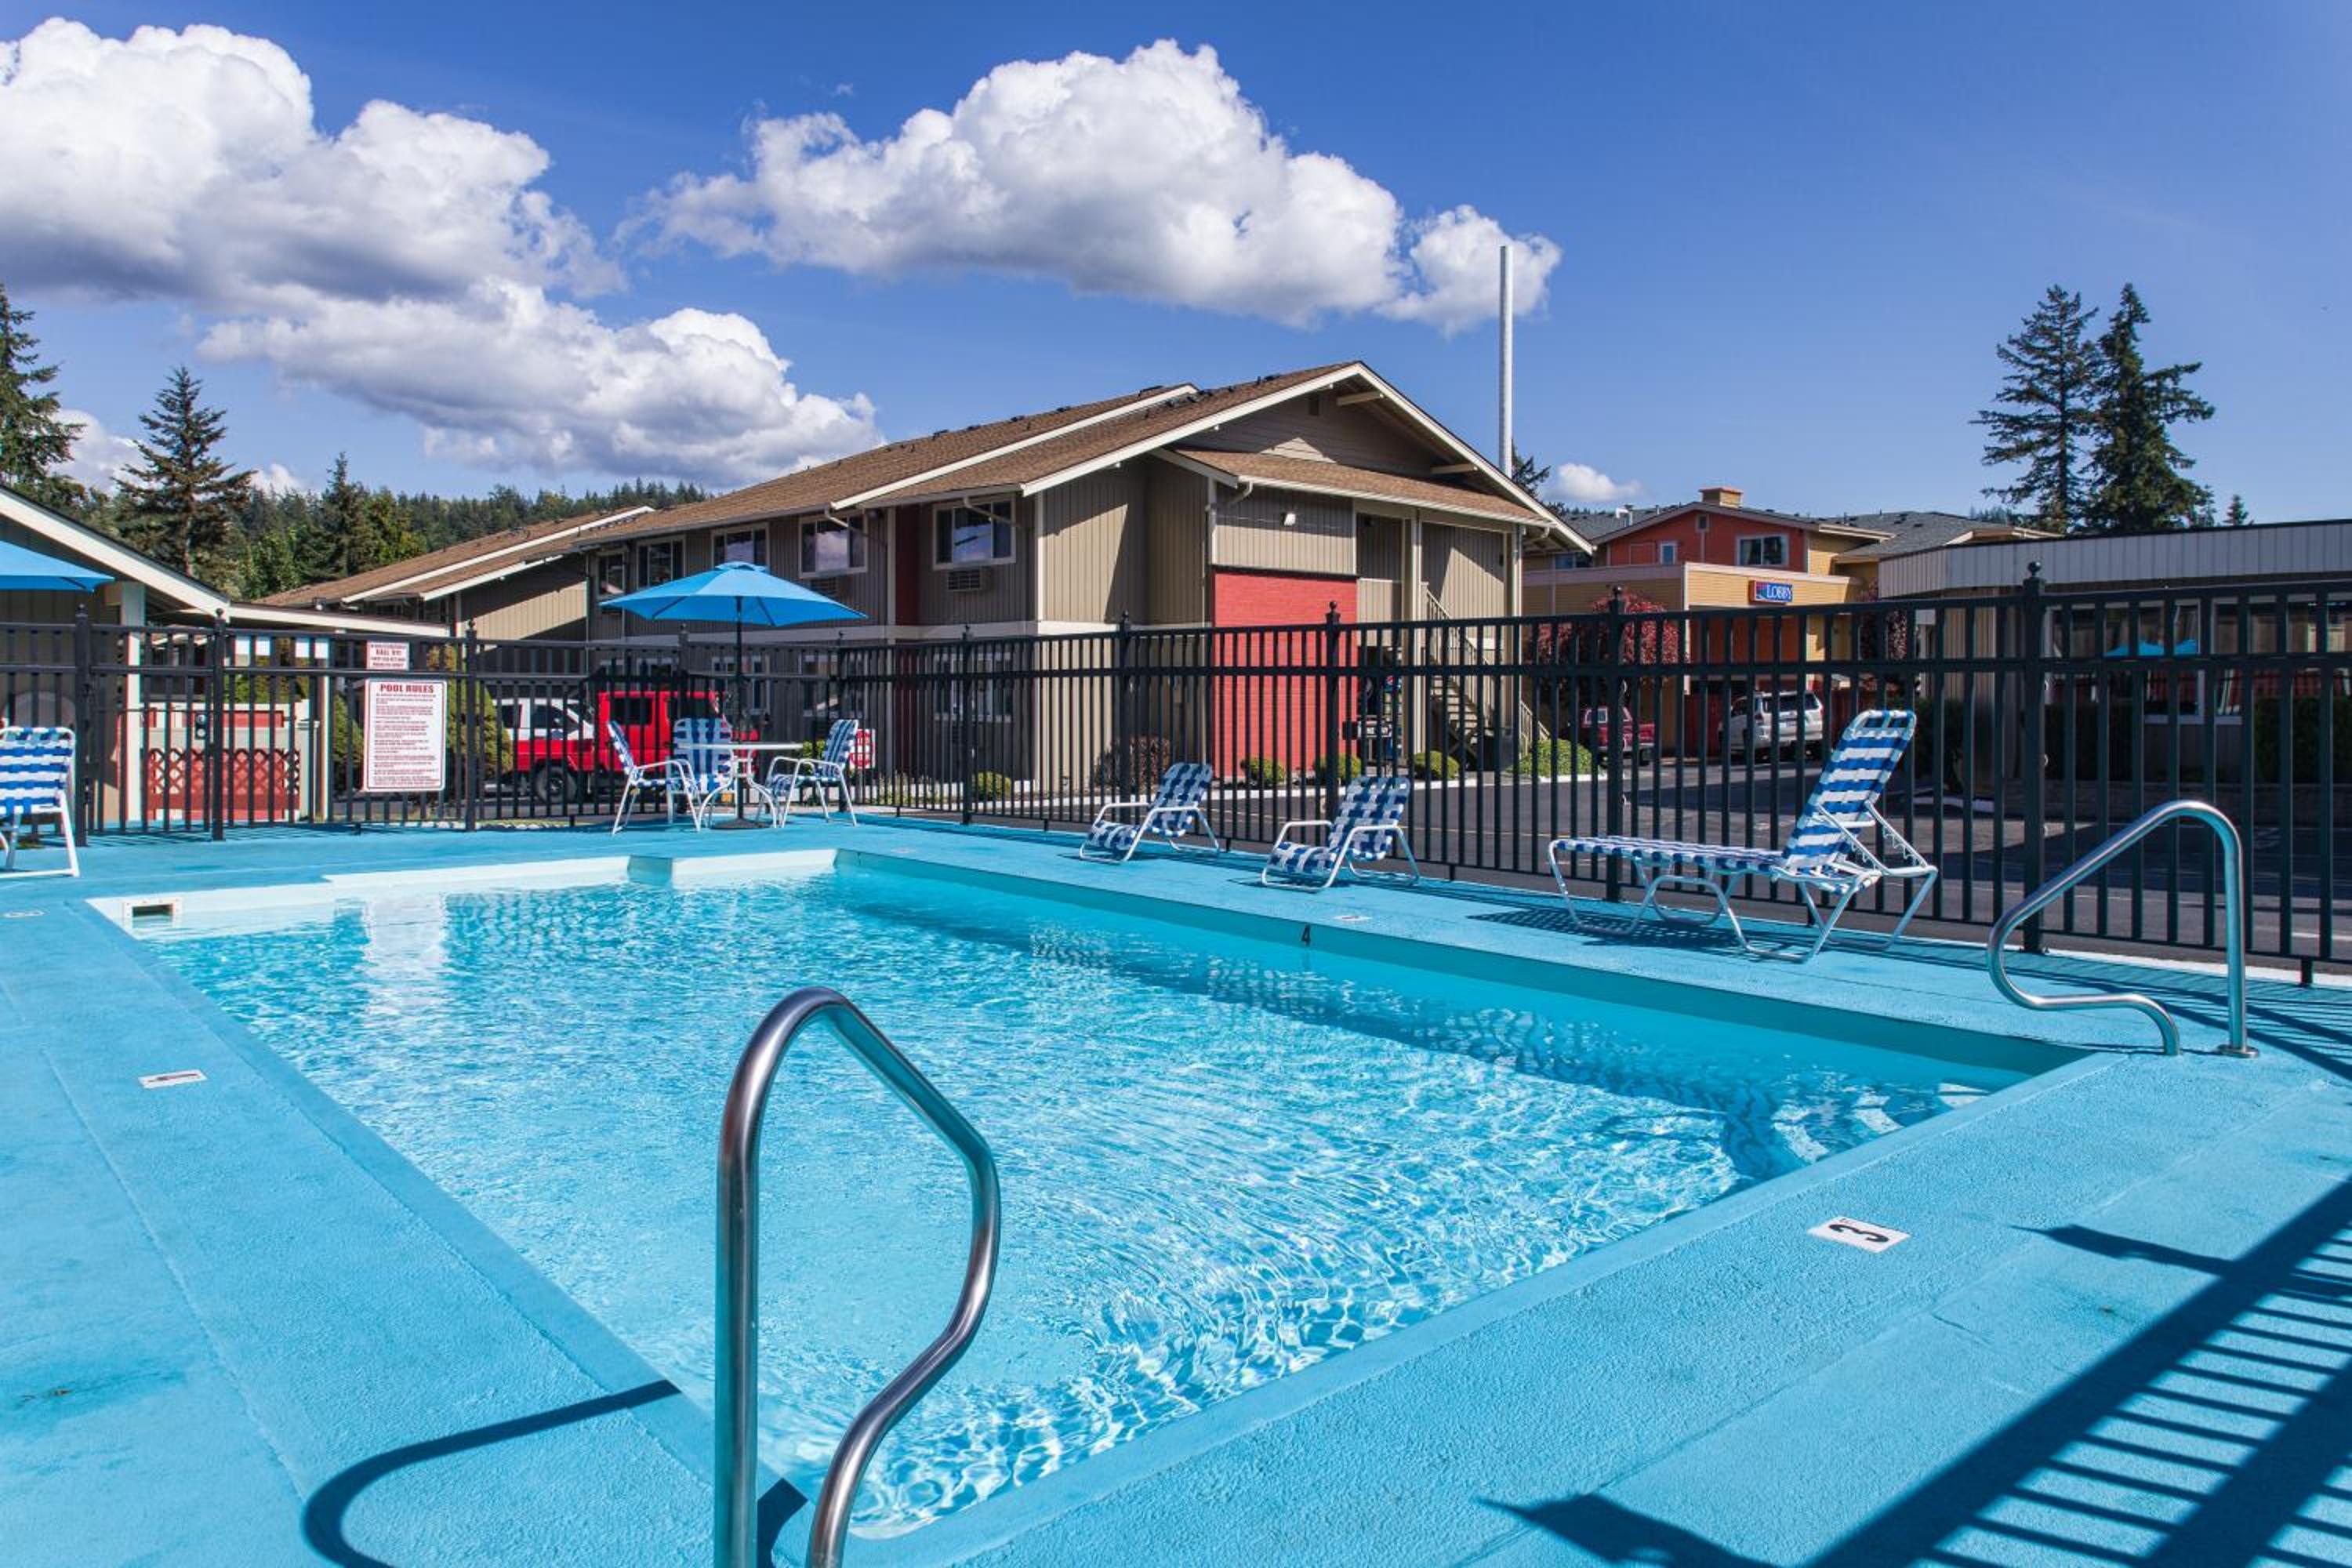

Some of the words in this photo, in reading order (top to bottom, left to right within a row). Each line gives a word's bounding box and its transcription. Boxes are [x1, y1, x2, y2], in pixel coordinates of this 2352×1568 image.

[1766, 584, 1791, 600] LOBBY
[380, 683, 403, 692] POOL
[406, 684, 434, 693] RULES
[1301, 925, 1311, 947] 4
[1828, 1224, 1889, 1243] 3
